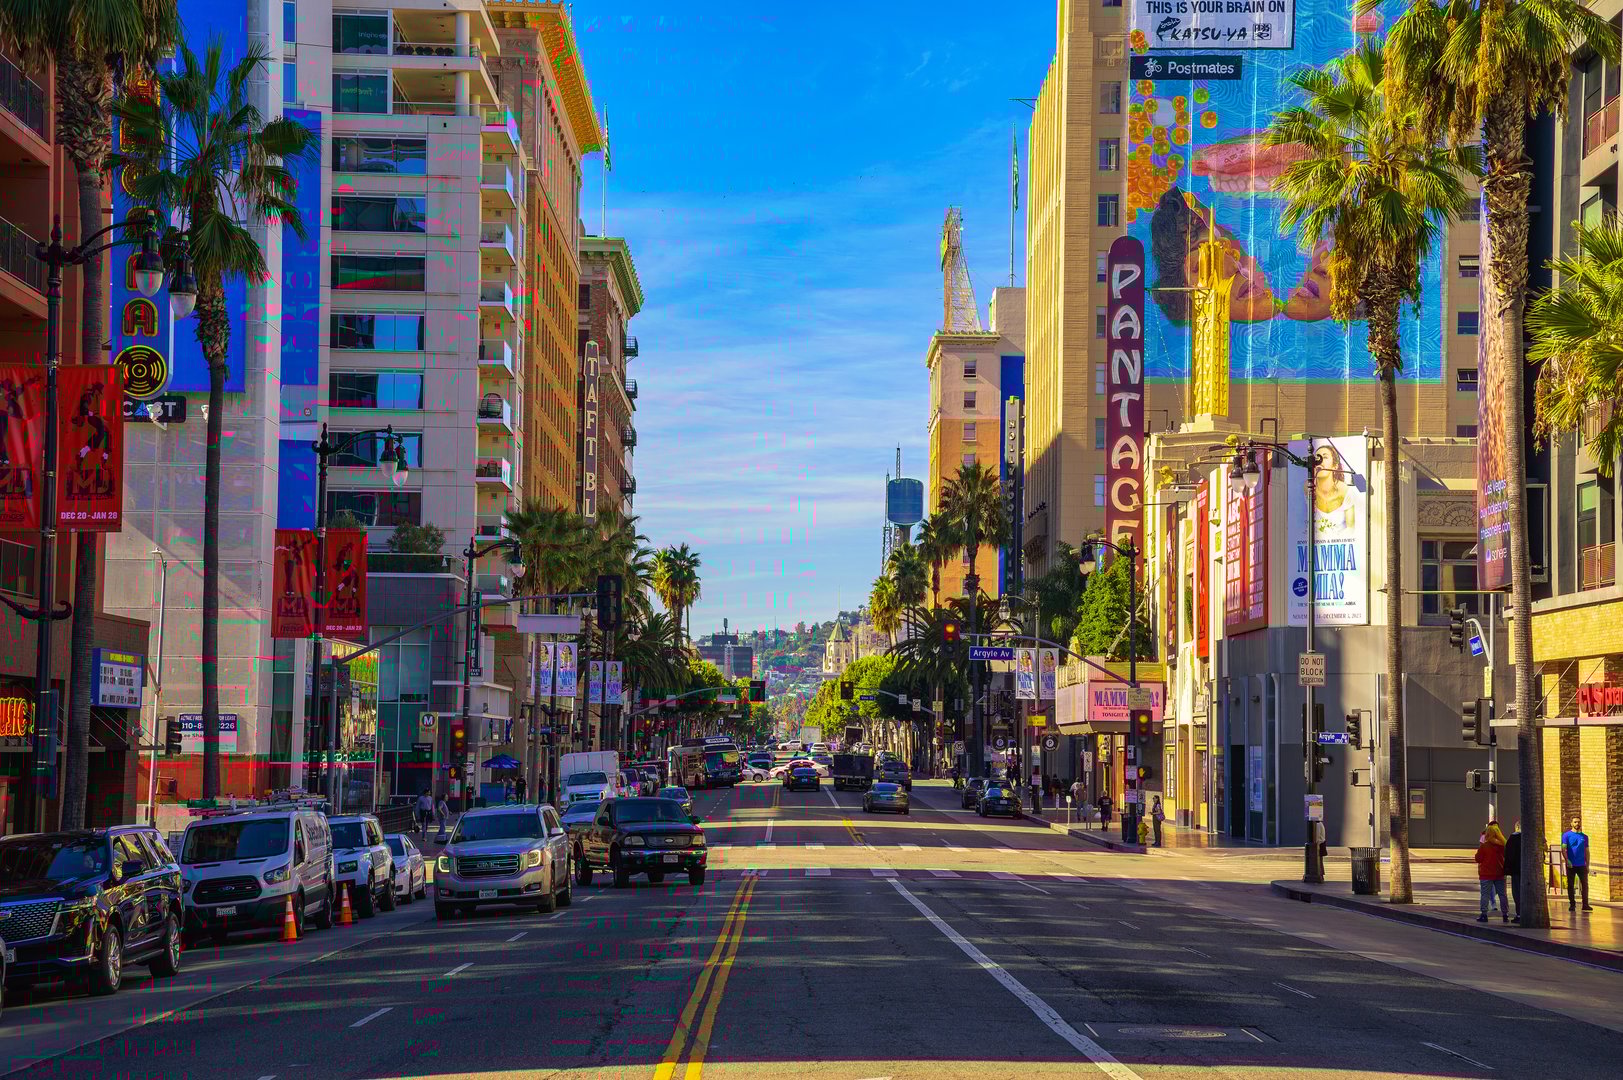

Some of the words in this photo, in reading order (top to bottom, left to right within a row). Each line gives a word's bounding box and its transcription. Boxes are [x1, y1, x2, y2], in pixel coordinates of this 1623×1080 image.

[1146, 0, 1172, 14] THIS
[1176, 0, 1187, 13] IS
[1192, 0, 1223, 13] YOUR
[1226, 0, 1264, 13] BRAIN
[1268, 0, 1285, 13] ON
[1171, 27, 1247, 41] KATSU-YA
[1168, 61, 1235, 74] Postmates
[586, 358, 598, 456] TAFT
[1110, 263, 1142, 555] PANTAGE
[60, 512, 75, 520] DEC
[76, 512, 88, 520] 20
[91, 512, 107, 520] JAN
[973, 650, 998, 659] Argyle
[1300, 657, 1309, 666] DO
[1312, 657, 1324, 666] NOT
[1300, 667, 1324, 676] BLOCK
[1094, 690, 1129, 707] MAMM
[1580, 681, 1604, 714] CVS
